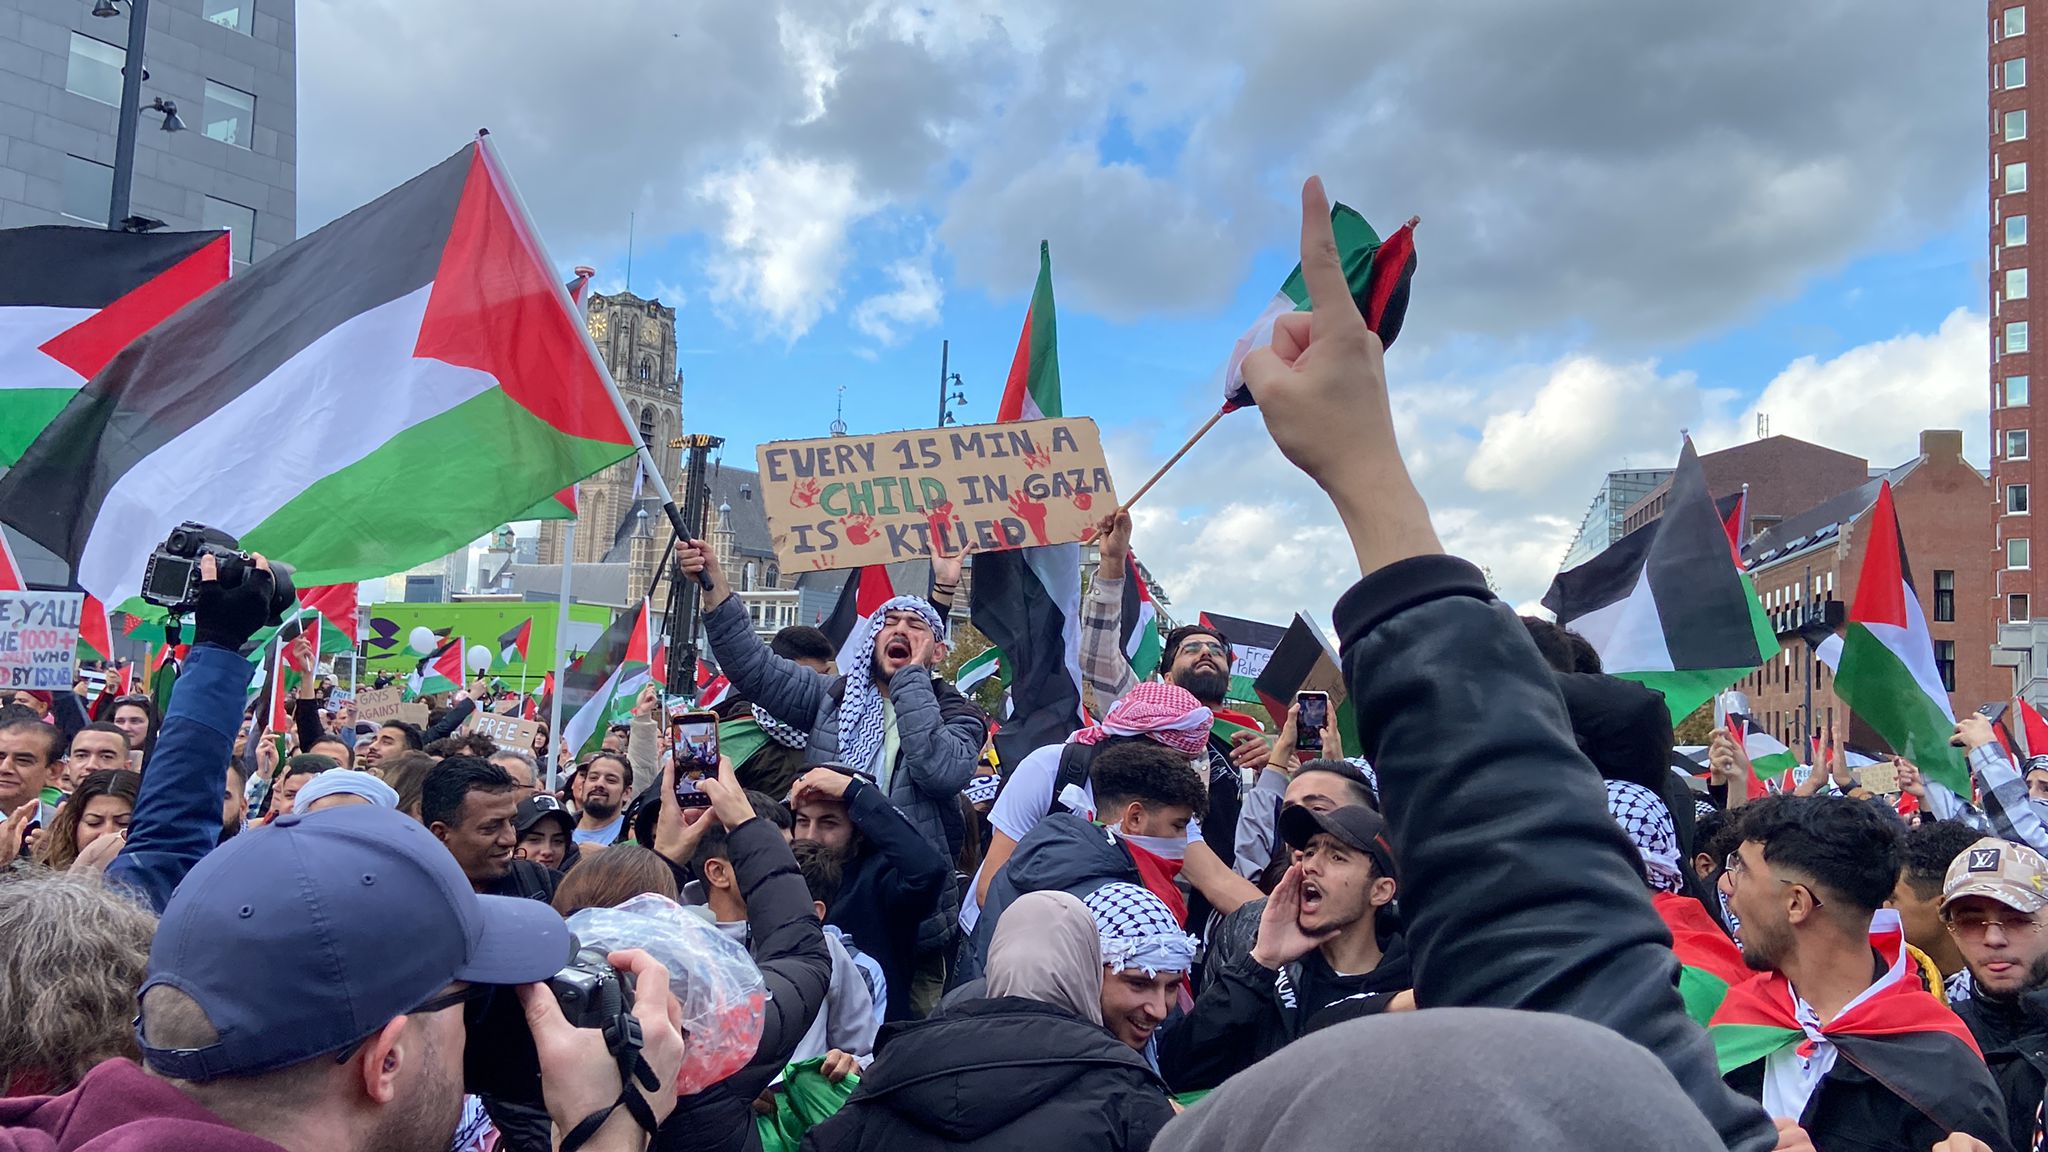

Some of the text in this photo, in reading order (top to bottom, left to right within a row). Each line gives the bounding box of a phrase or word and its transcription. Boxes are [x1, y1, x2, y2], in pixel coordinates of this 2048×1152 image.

[765, 426, 1078, 481] EVERY 15 MIN A
[819, 467, 1111, 516] CHILD IN GAZA
[790, 517, 1026, 557] IS KILLED
[19, 600, 79, 629] Y'ALL
[33, 651, 70, 663] WHO
[12, 667, 33, 686] BY
[361, 690, 389, 704] GAYS
[360, 703, 399, 720] AGAINST
[476, 717, 518, 741] FREE
